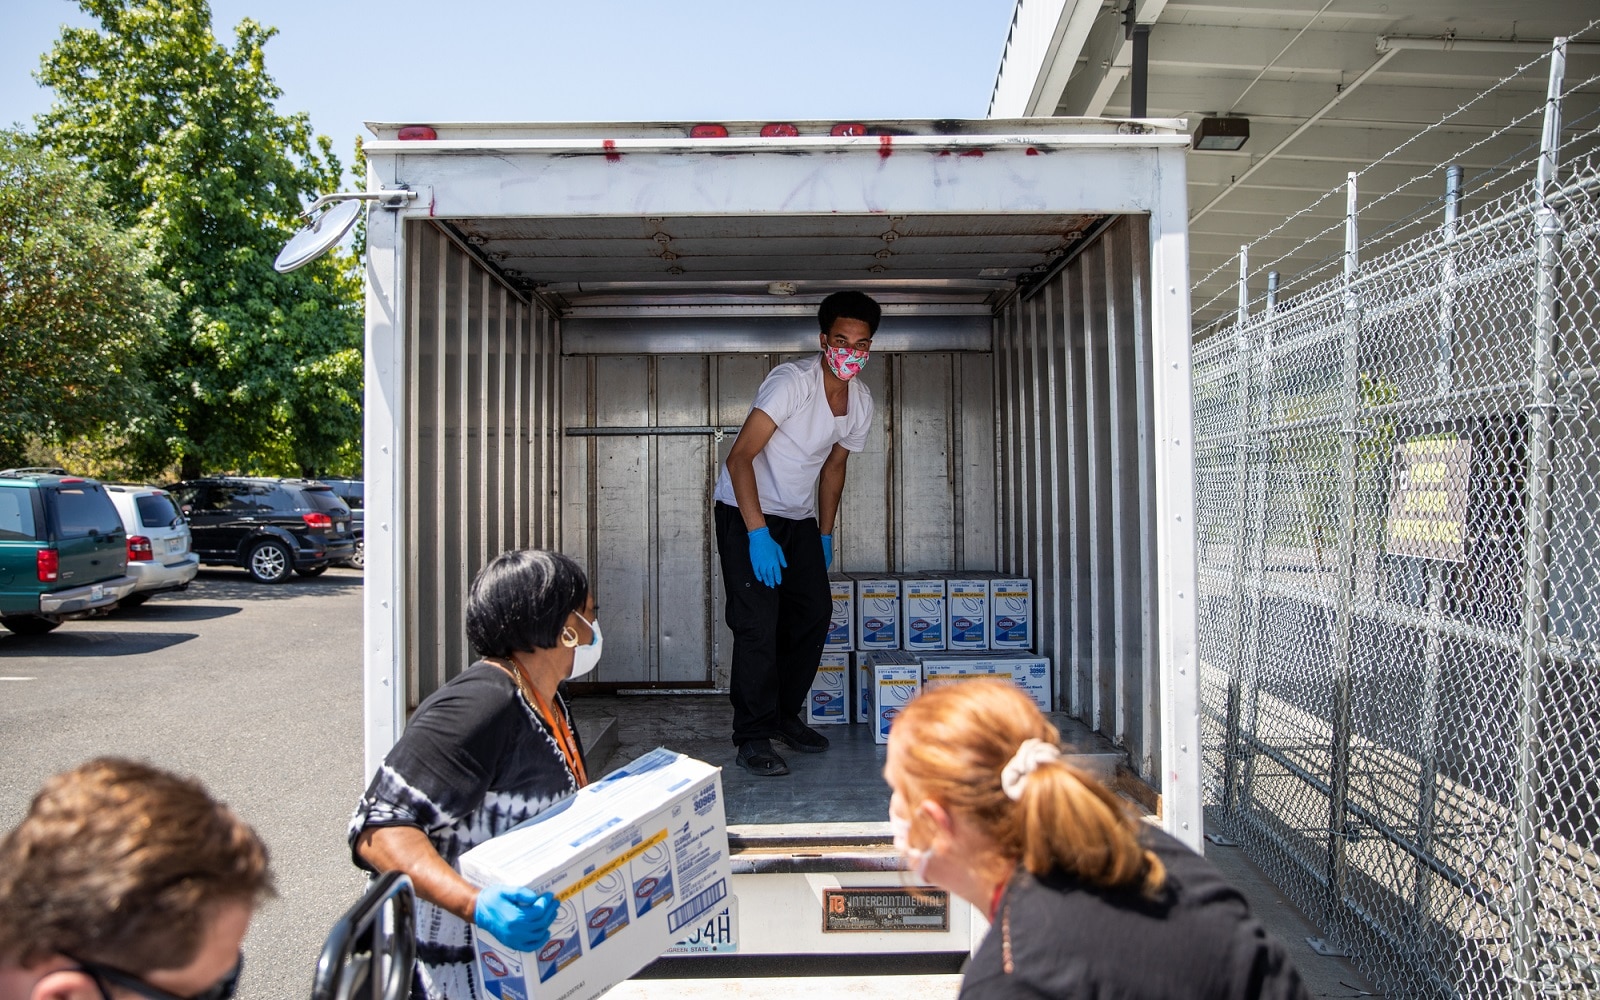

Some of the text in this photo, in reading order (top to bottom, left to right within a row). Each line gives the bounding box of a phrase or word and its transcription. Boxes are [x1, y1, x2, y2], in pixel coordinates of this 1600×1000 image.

[693, 790, 716, 811] 30966
[638, 880, 655, 896] CLOROX
[849, 895, 942, 907] INTERCONTINENTAL
[592, 910, 609, 927] CLOROX
[542, 941, 560, 959] CLOROX
